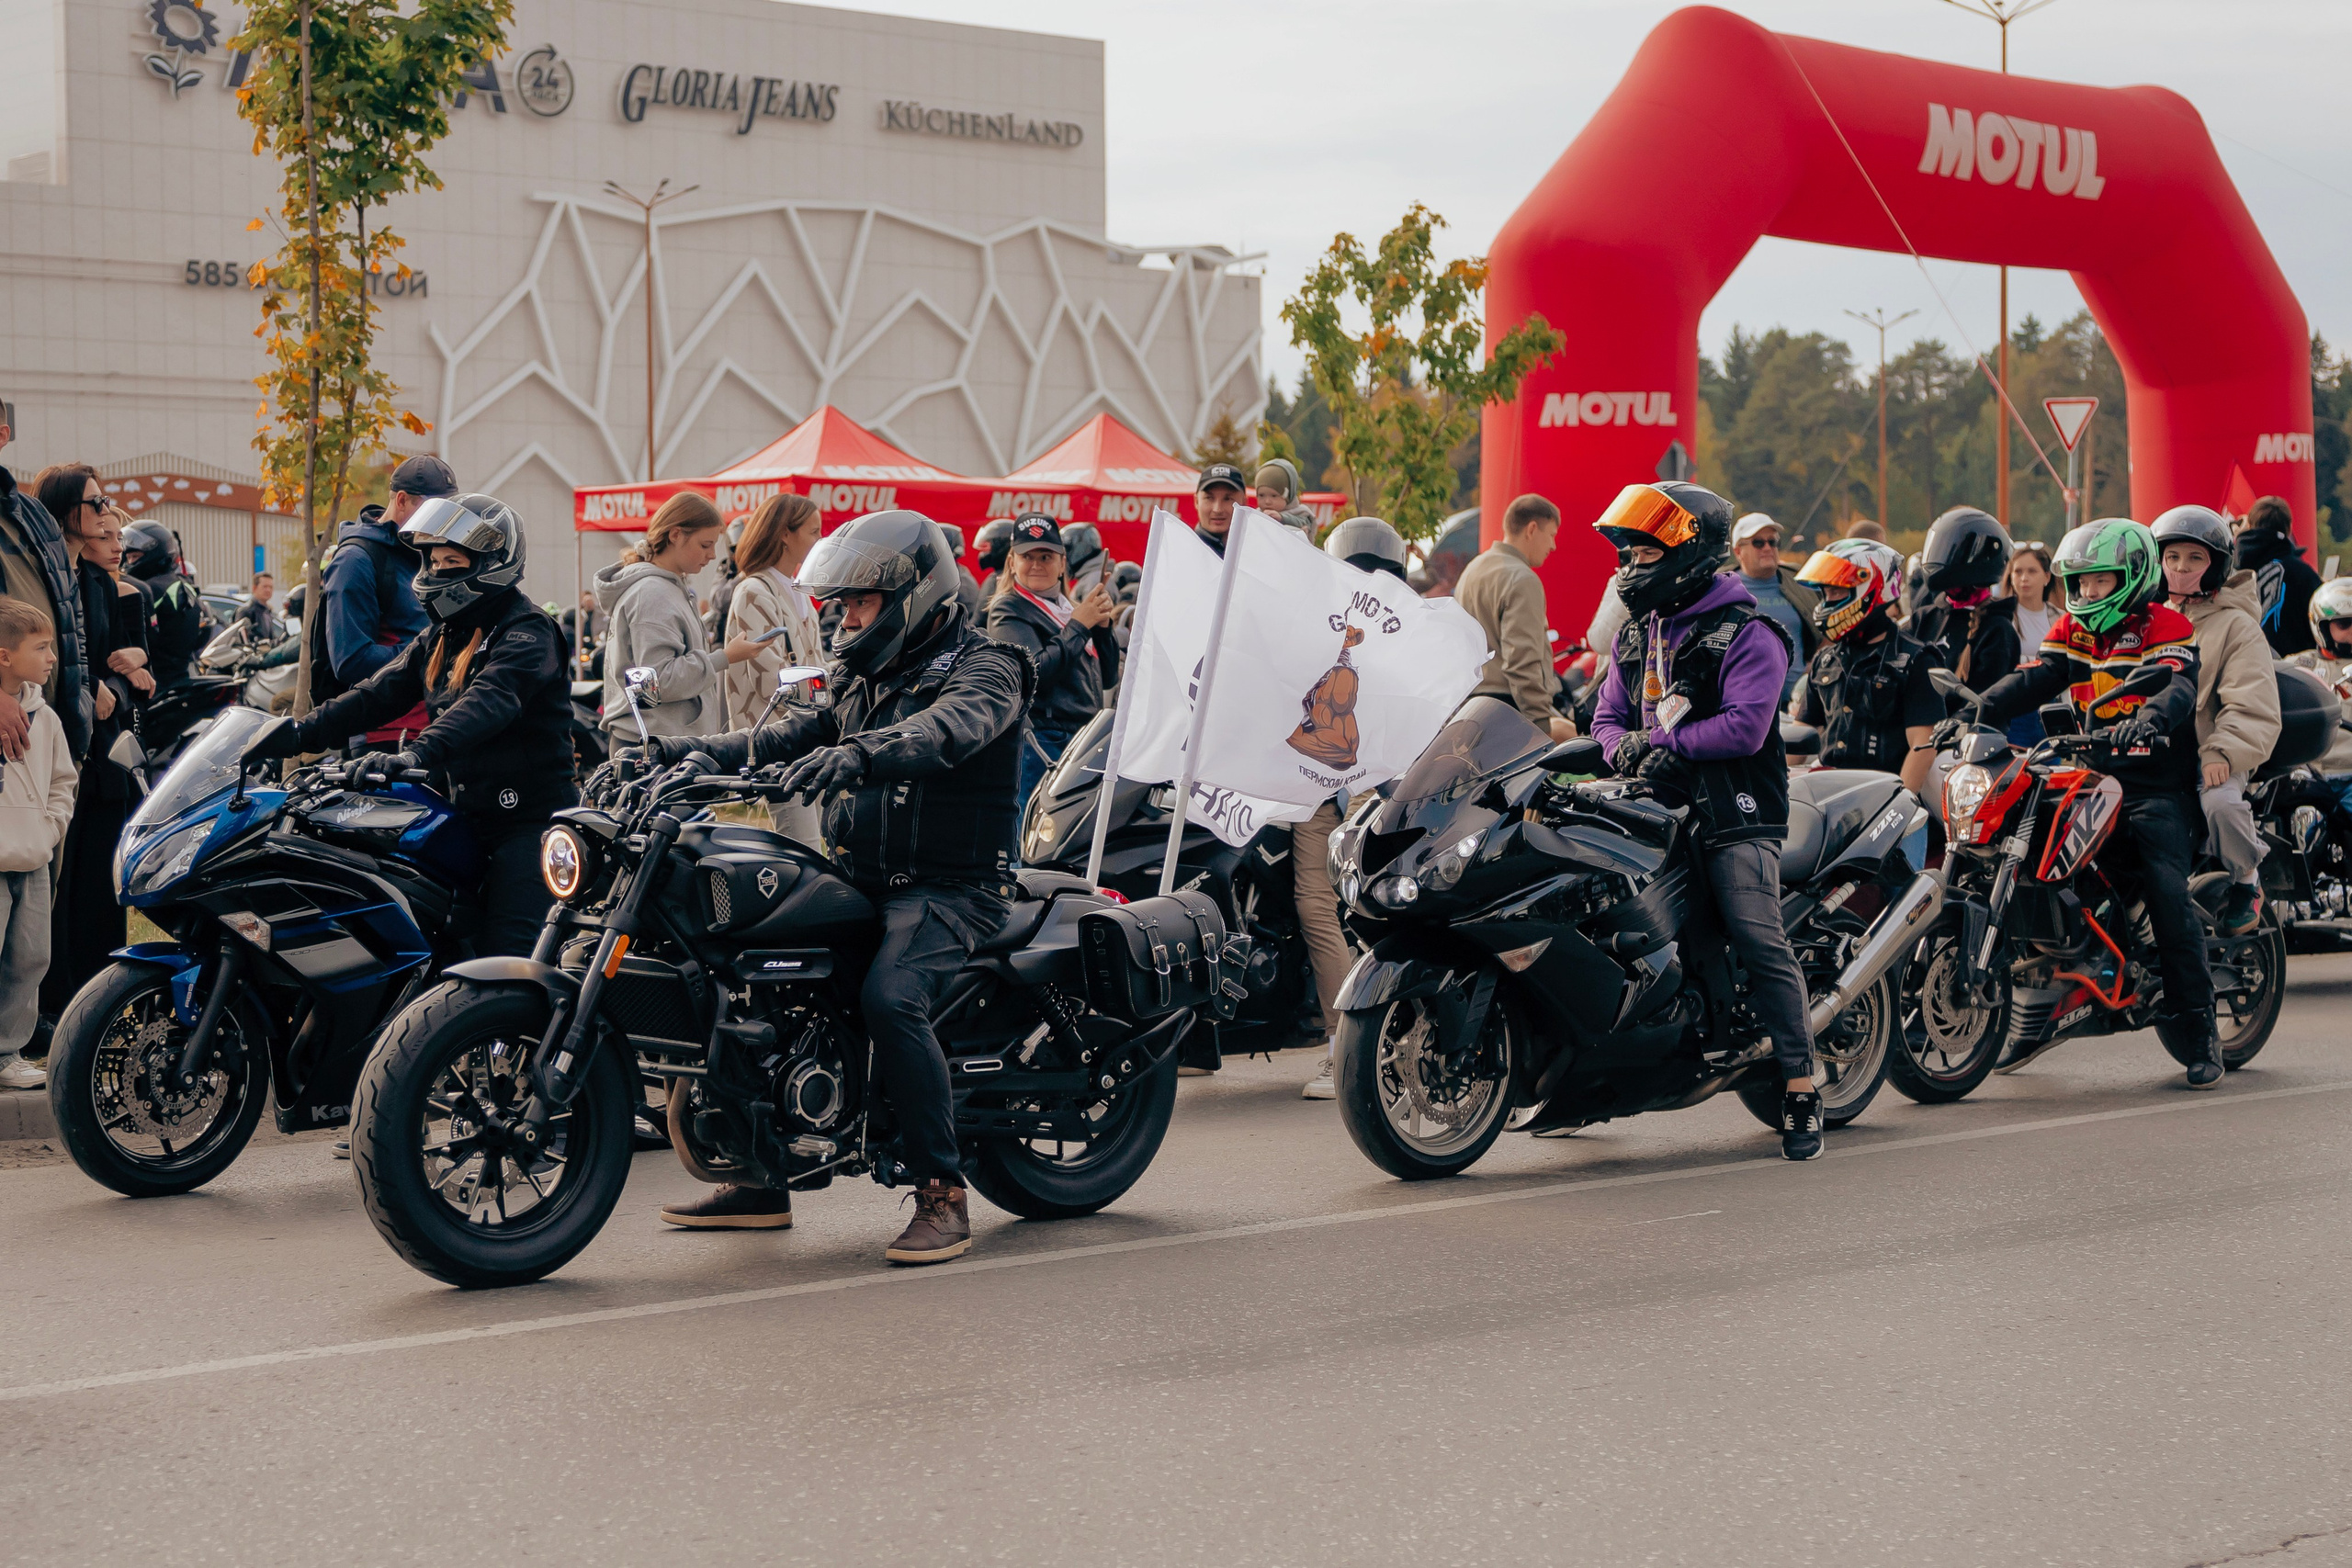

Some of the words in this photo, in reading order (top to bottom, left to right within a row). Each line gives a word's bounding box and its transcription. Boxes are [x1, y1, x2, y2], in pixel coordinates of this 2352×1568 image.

[1917, 102, 2107, 200] MOTUL
[187, 259, 239, 287] 585
[1538, 390, 1678, 428] MOTUL
[582, 491, 647, 521] MOTUL
[808, 483, 899, 513] MOTUL
[986, 491, 1074, 520] MOTUL
[1018, 518, 1052, 531] SUZUKI
[509, 632, 536, 641] MCP
[1299, 765, 1343, 788] ПЕРМСКИЙ
[336, 802, 375, 823] Ninja
[502, 793, 515, 805] 13
[1738, 796, 1755, 808] 13
[1869, 808, 1898, 842] ZZR
[2058, 1004, 2093, 1030] KTM
